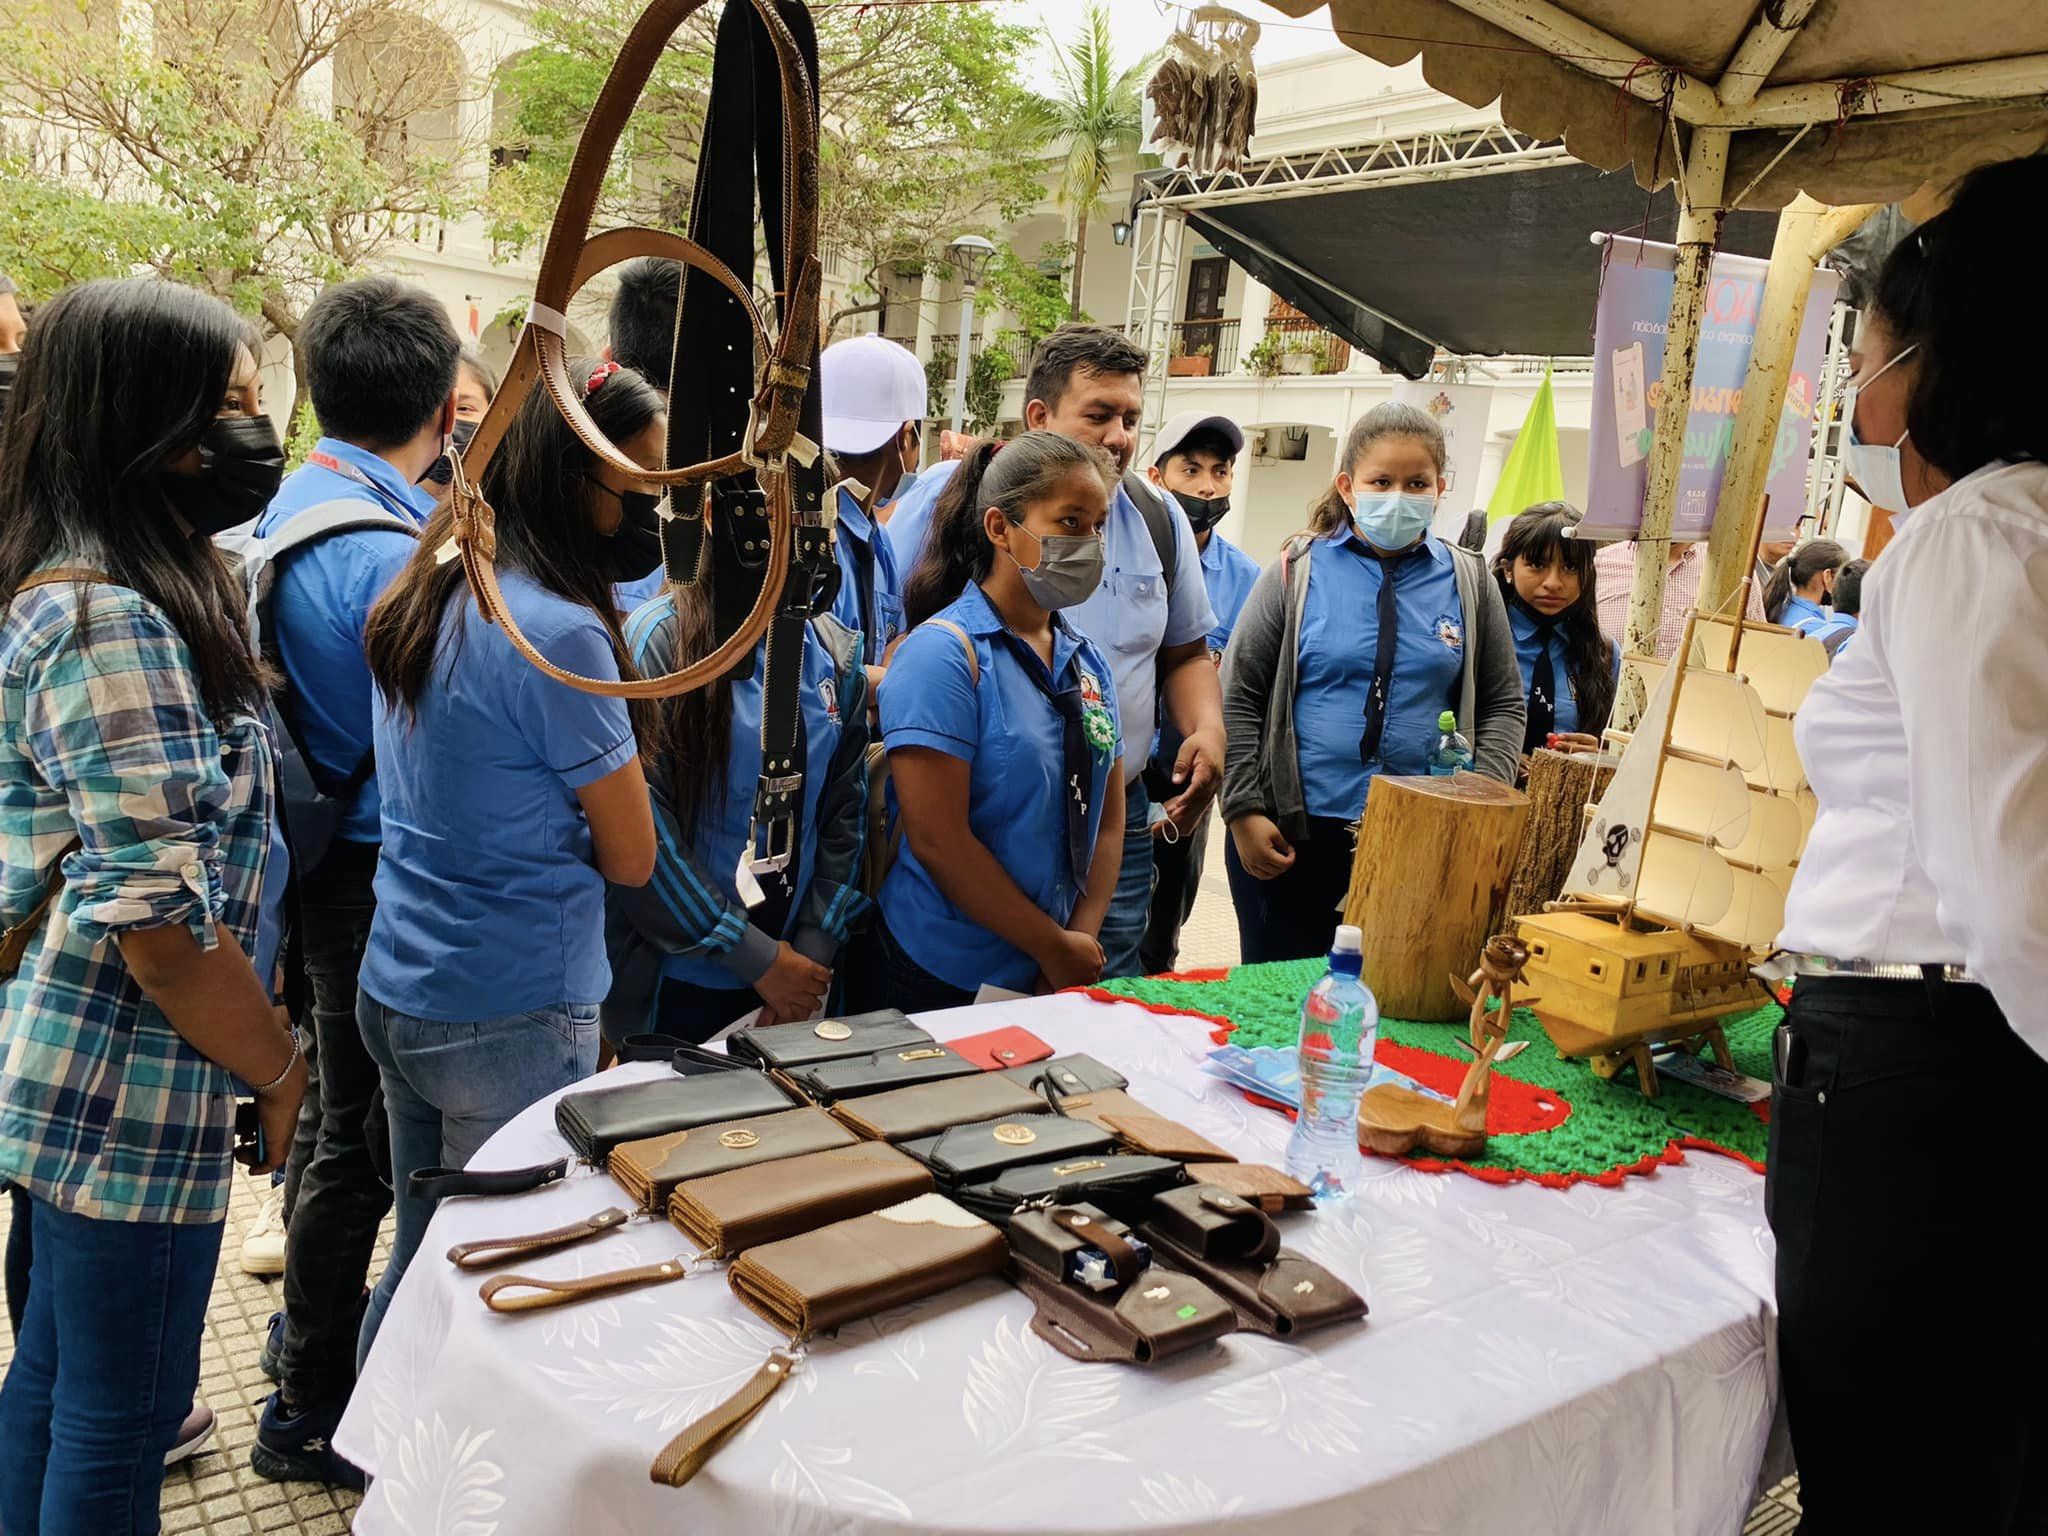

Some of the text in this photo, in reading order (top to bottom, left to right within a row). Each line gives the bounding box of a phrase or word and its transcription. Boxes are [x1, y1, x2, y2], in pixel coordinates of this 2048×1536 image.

[1534, 686, 1553, 712] JAP
[1070, 773, 1087, 815] JAP
[779, 873, 793, 897] AP
